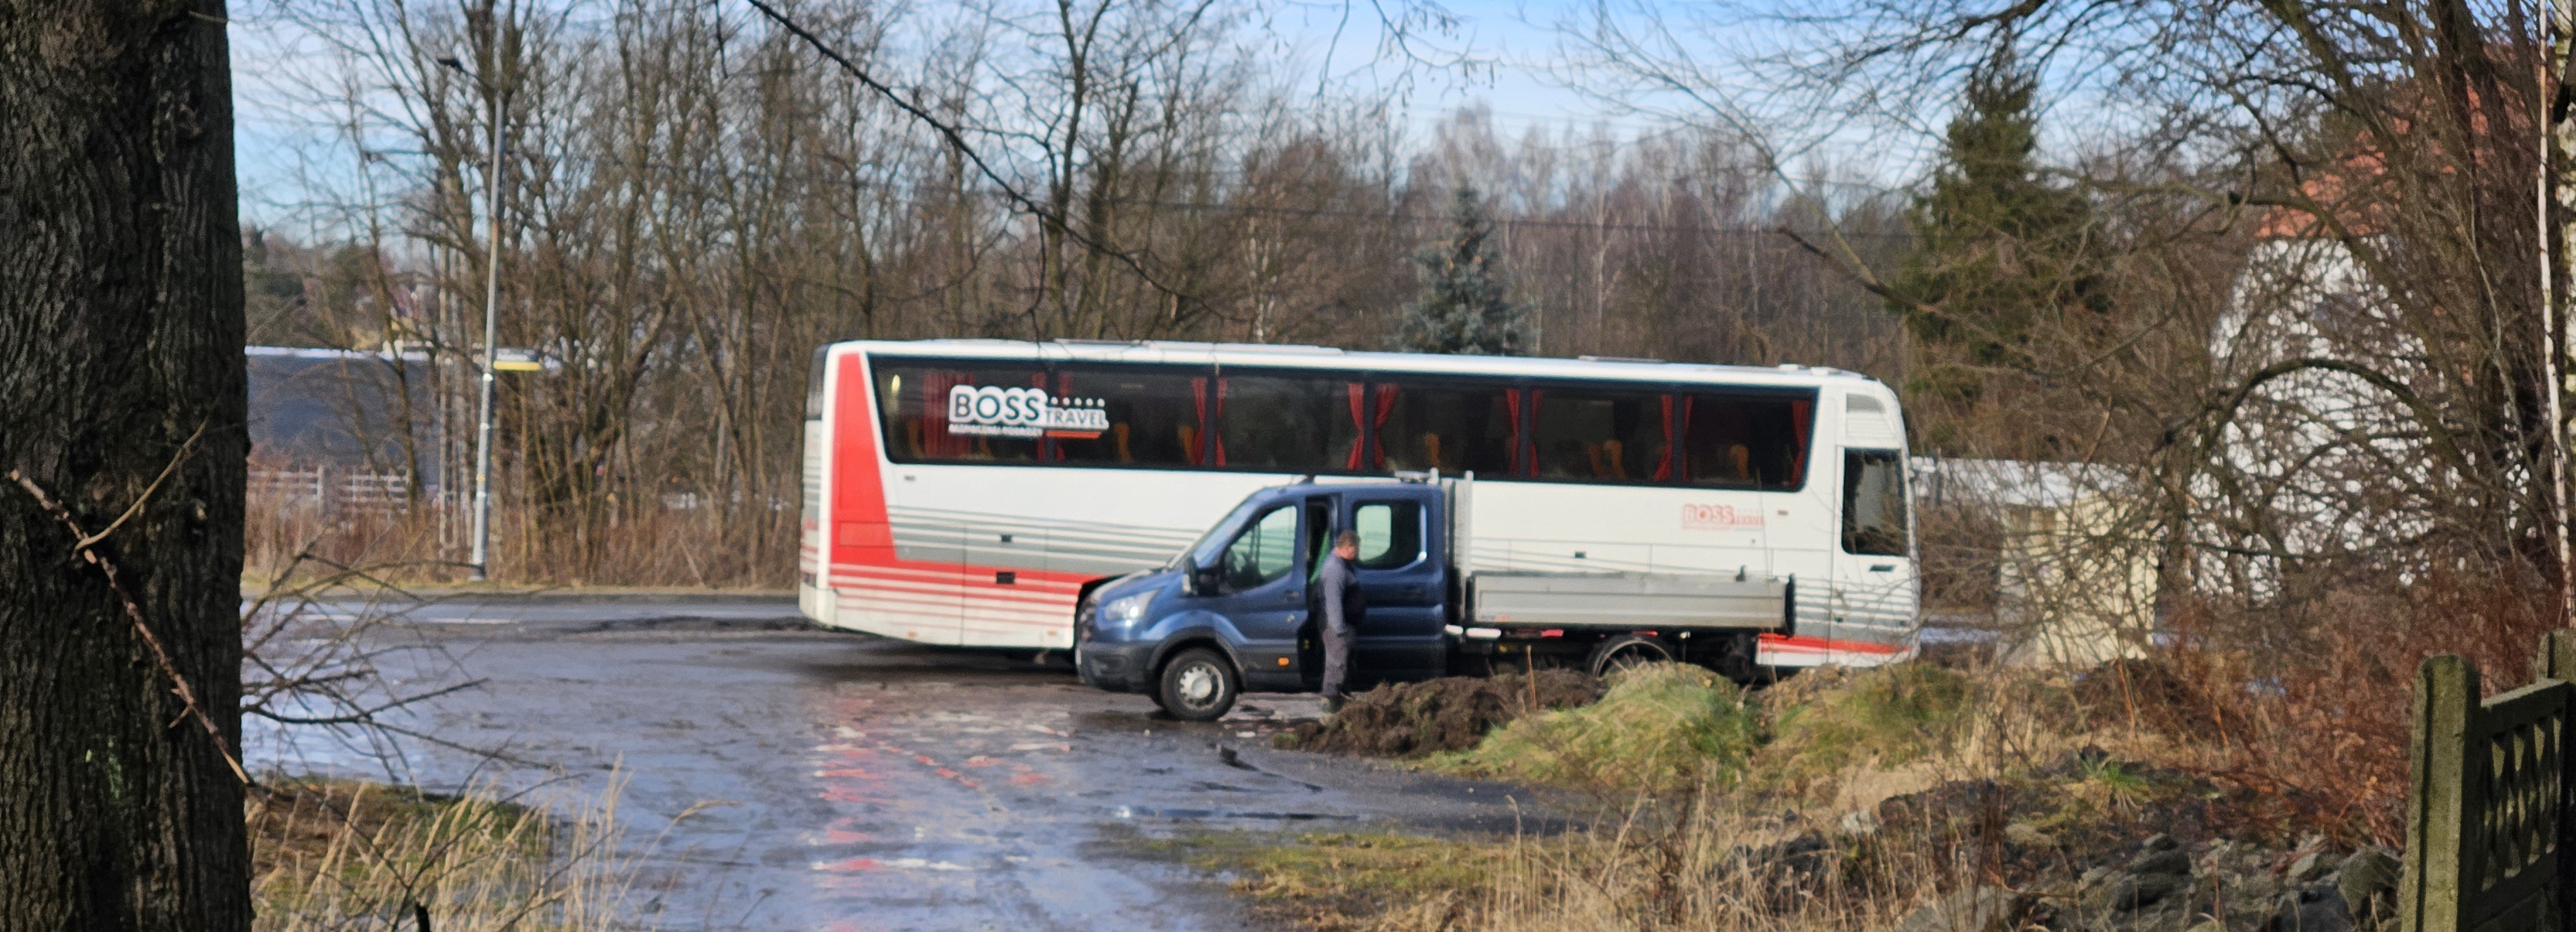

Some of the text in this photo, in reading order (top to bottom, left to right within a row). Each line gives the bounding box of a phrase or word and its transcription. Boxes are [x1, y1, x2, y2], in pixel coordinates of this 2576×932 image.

[952, 389, 1107, 428] BOSS TRAVEL
[1684, 504, 1733, 524] BOSS
